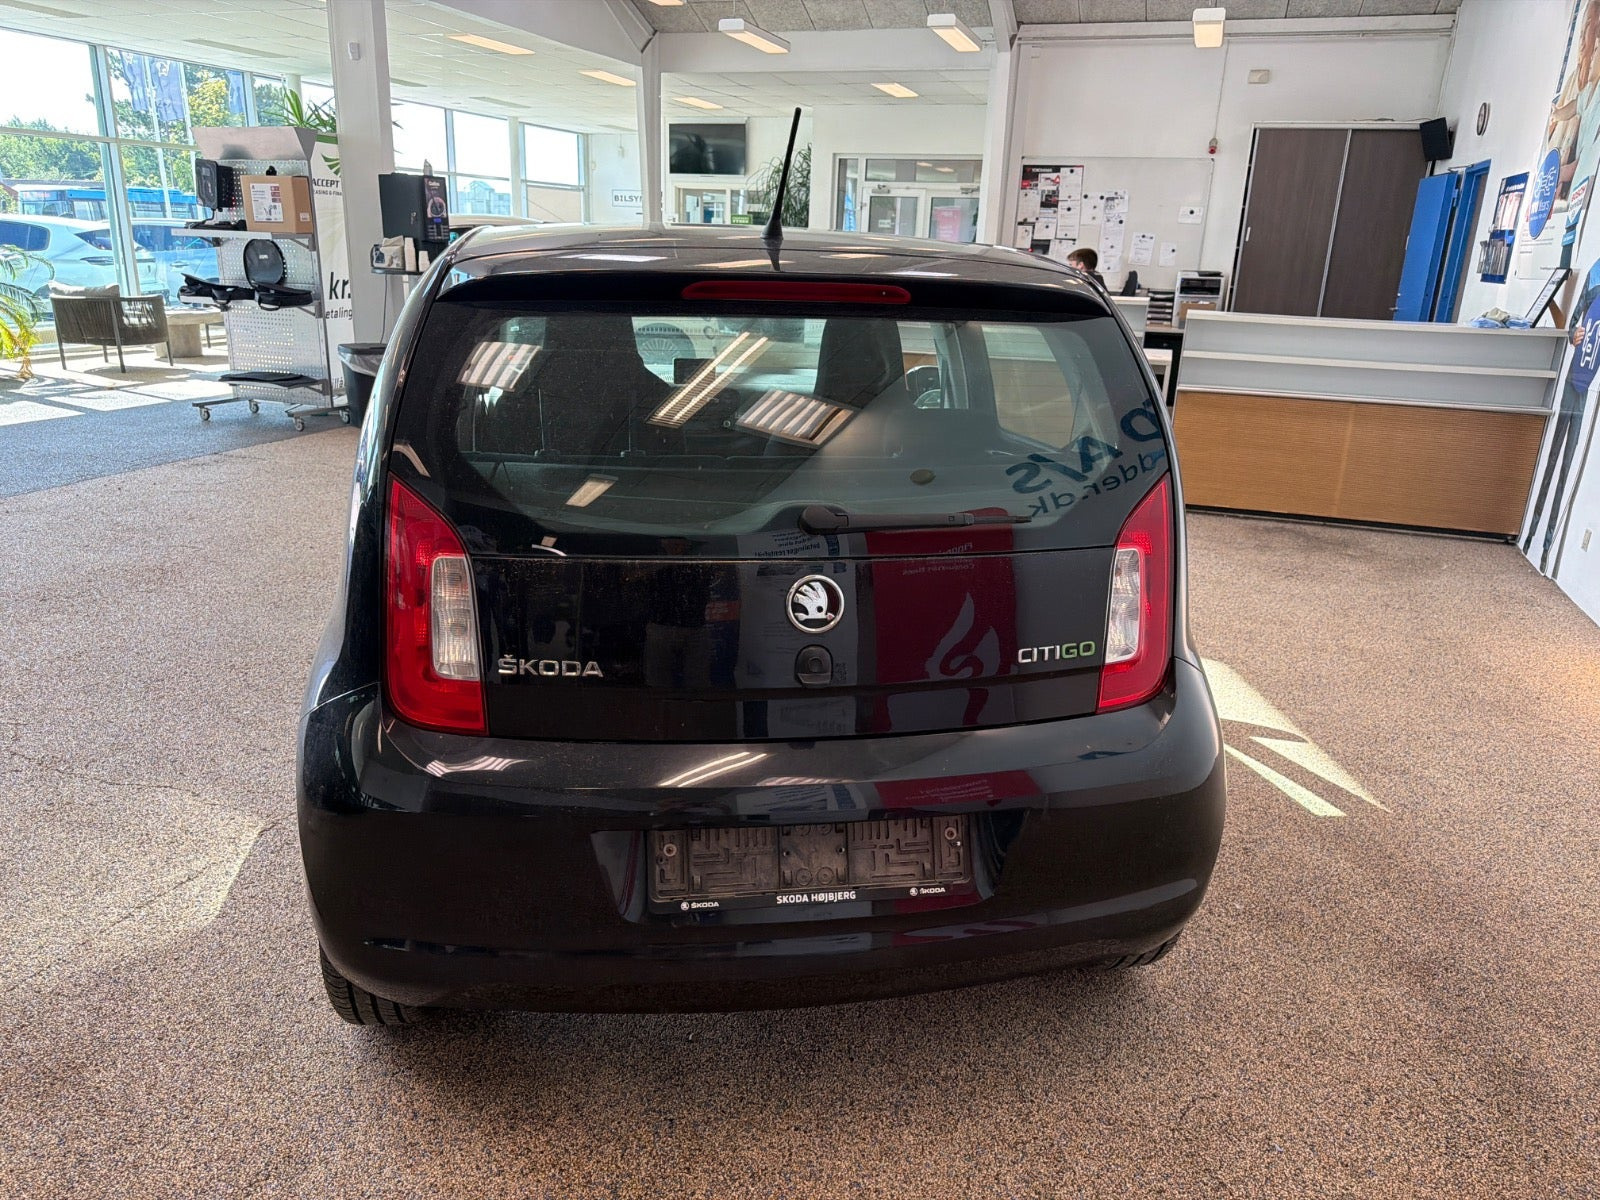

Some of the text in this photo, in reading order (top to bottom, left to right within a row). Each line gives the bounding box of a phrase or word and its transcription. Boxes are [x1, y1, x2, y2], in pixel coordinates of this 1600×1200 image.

[313, 177, 340, 188] ACCEPT
[329, 271, 351, 300] kr.
[1017, 640, 1097, 664] CITIGO
[497, 654, 604, 678] ŠKODA
[776, 890, 857, 904] SKODA HØJBJERG
